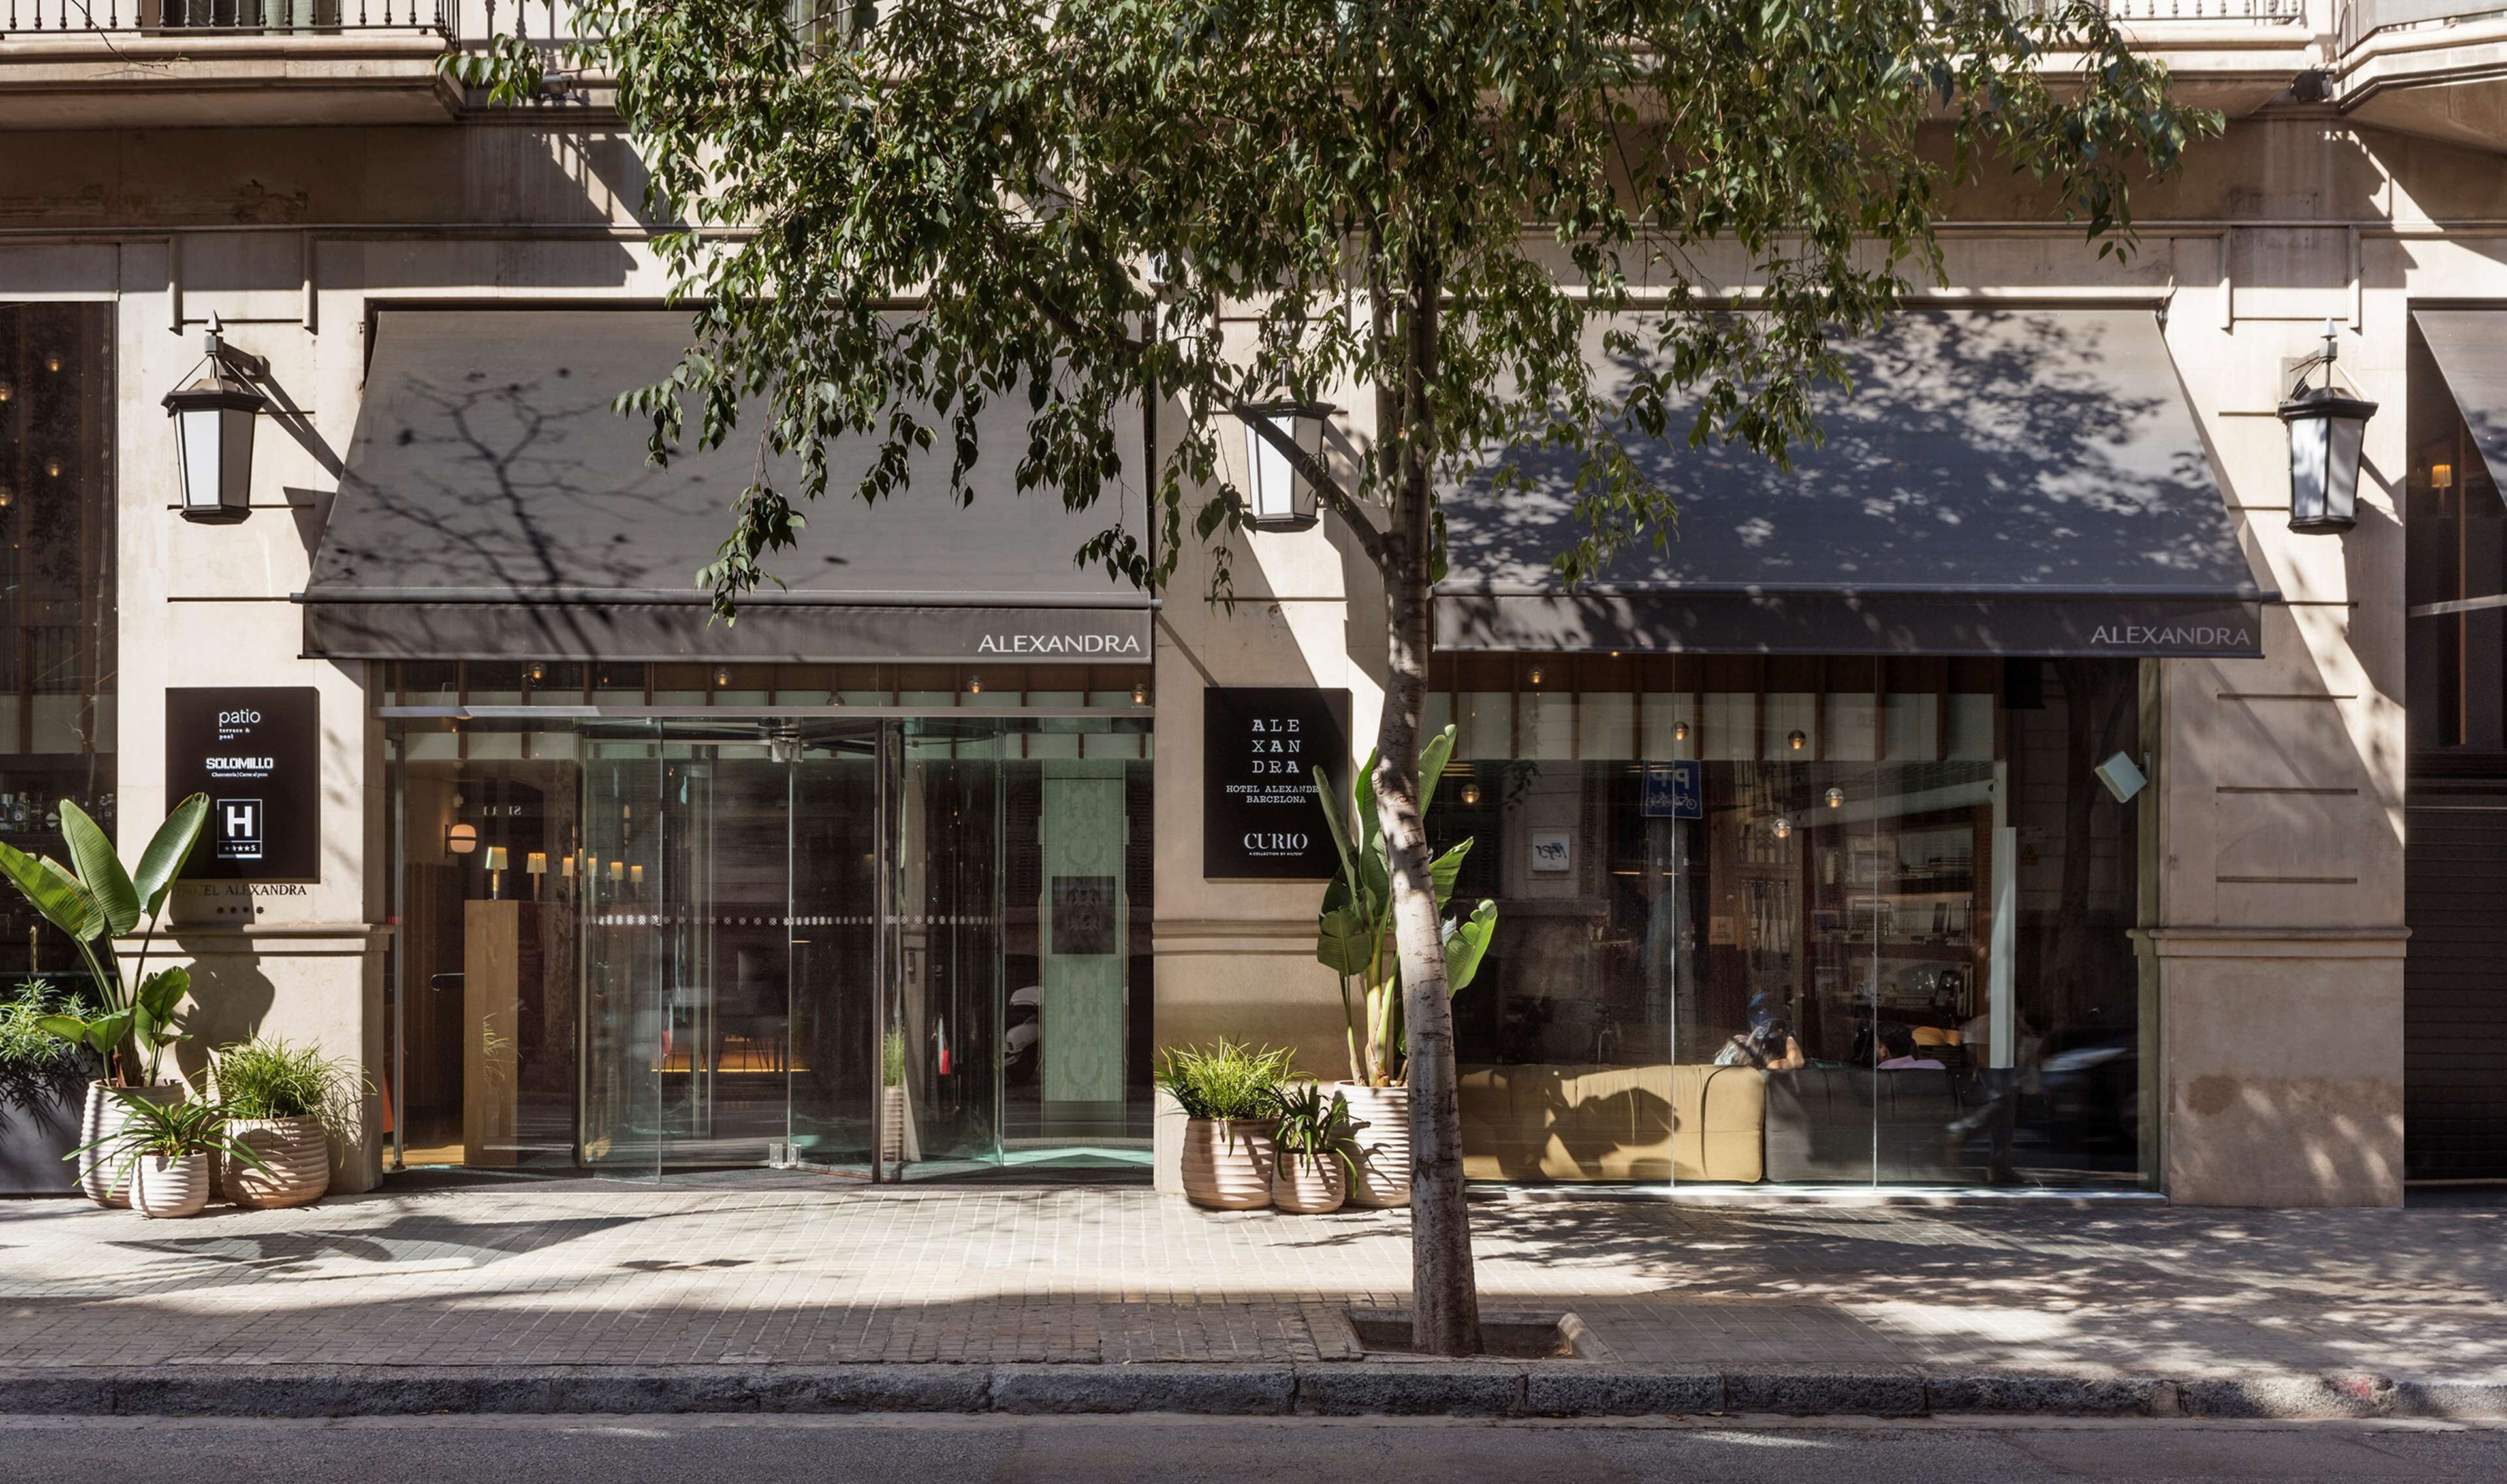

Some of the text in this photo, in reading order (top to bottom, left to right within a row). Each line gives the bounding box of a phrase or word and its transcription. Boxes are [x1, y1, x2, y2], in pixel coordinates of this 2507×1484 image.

[2090, 625, 2251, 645] ALEXANDRA
[977, 634, 1141, 652] ALEXANDRA
[219, 708, 260, 727] patio
[1252, 719, 1300, 732] ALE
[1252, 740, 1301, 752] XAN
[206, 757, 273, 769] SOLOMILLO
[1252, 761, 1300, 773] DRA
[1225, 785, 1319, 793] HOTEL ALEXANDR
[227, 806, 253, 837] H
[1244, 832, 1308, 849] CURIO
[225, 884, 307, 896] ALEXANDRA
